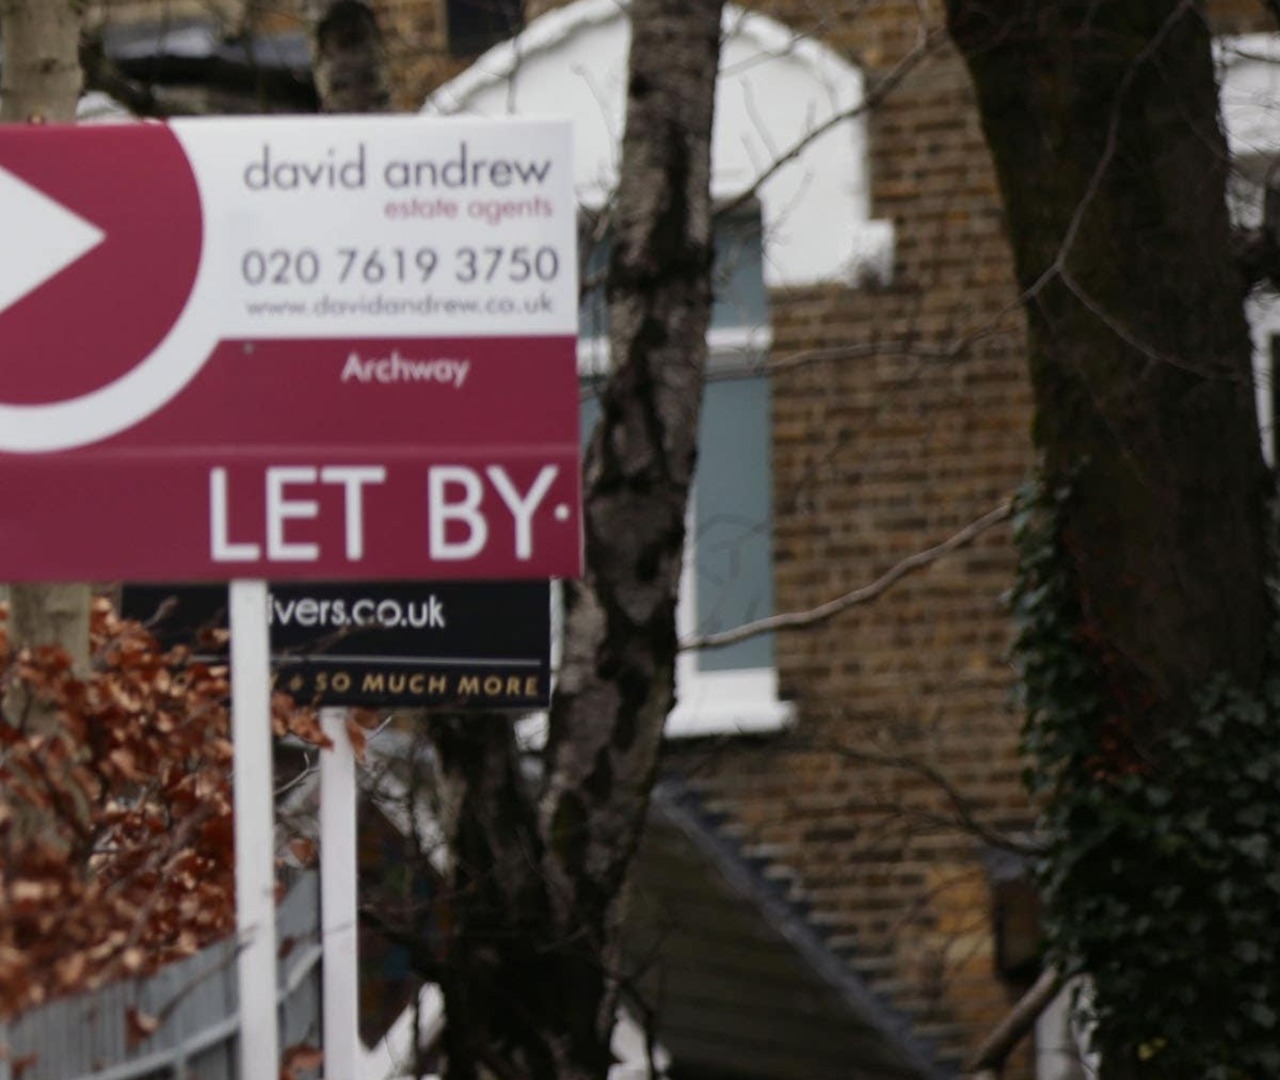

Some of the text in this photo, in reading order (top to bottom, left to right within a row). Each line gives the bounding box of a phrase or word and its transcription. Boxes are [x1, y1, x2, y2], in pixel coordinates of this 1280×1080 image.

[243, 143, 552, 191] david andrew
[383, 197, 553, 227] estate agents
[241, 247, 559, 286] 020 7619 3750
[244, 294, 553, 318] www.davidandrew.co.uk
[341, 352, 469, 388] Archway
[209, 466, 558, 561] LET BY
[315, 672, 351, 692] SO
[361, 672, 448, 694] MUCH
[457, 675, 539, 696] MORE
